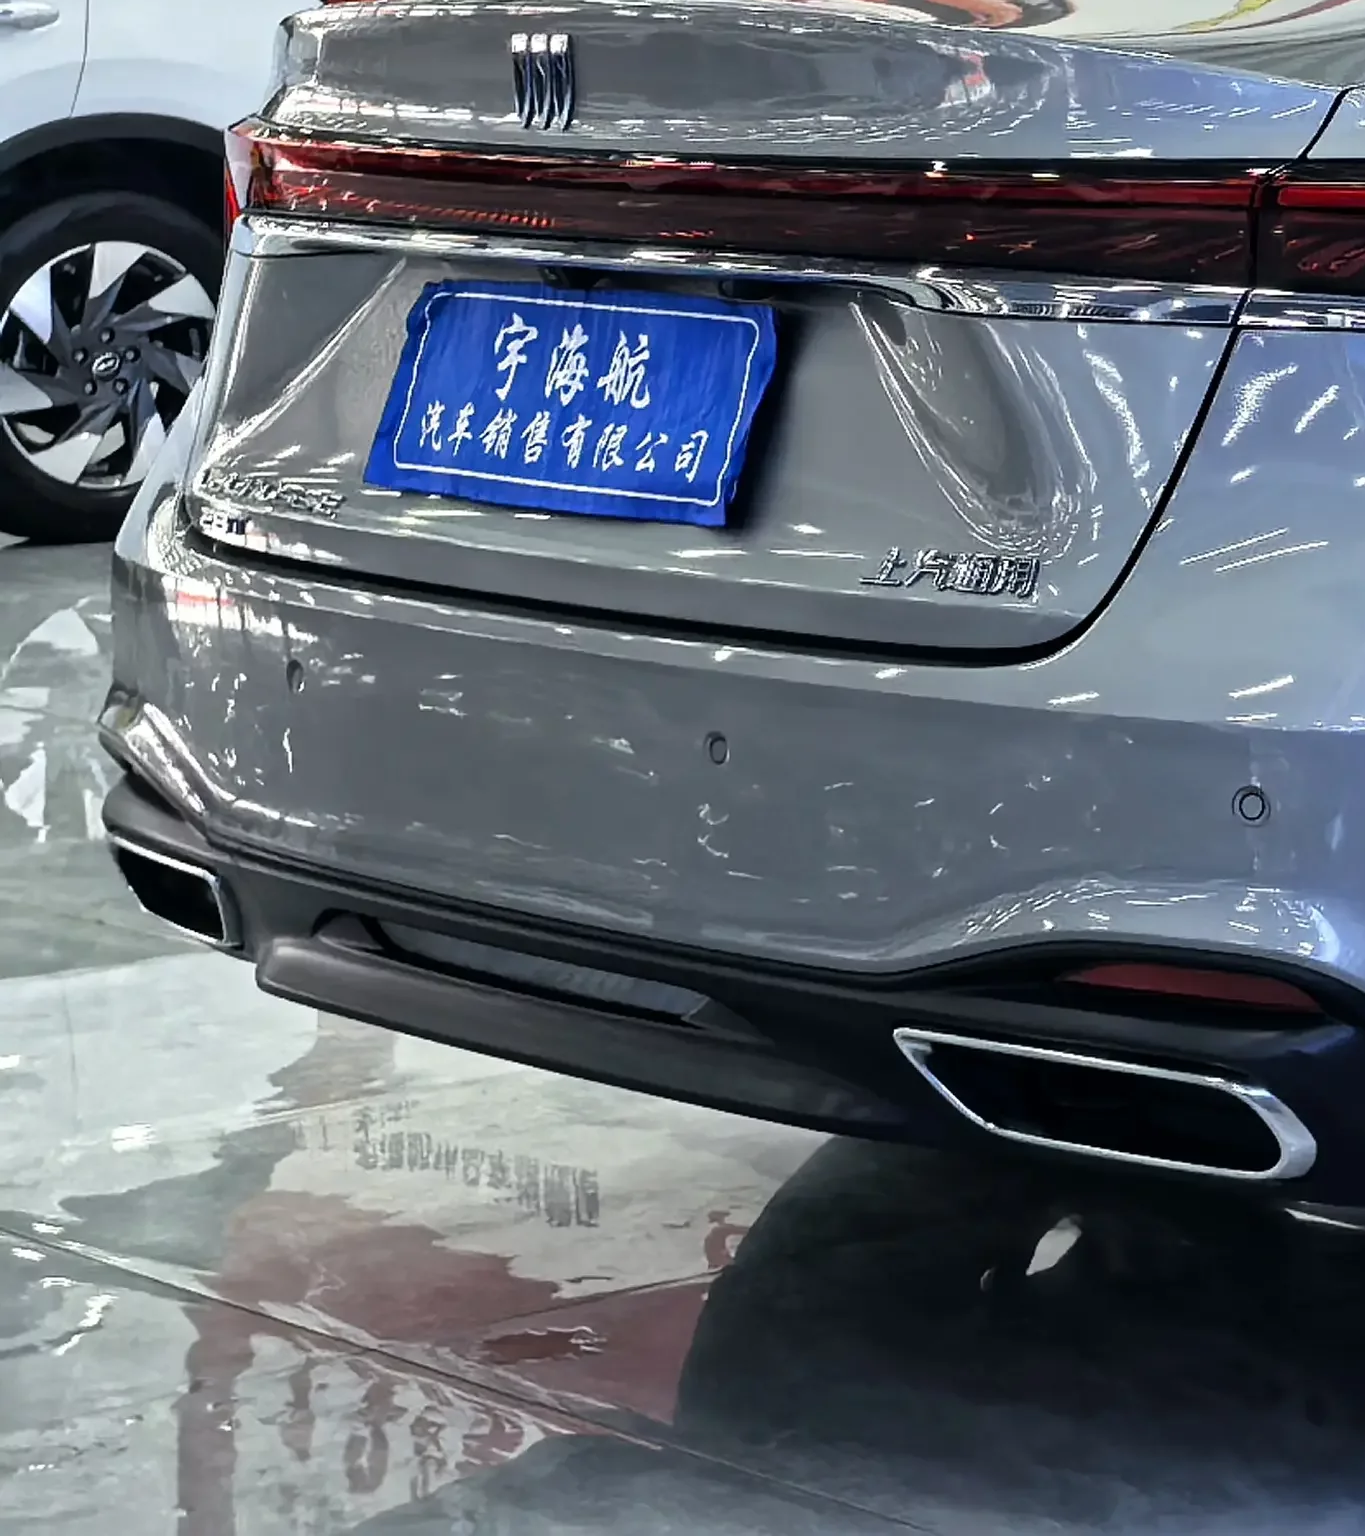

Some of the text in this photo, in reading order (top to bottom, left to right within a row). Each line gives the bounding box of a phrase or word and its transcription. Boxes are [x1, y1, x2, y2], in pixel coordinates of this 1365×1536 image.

[494, 312, 650, 409] 宇海航
[419, 400, 709, 483] 汽车销售有限公司
